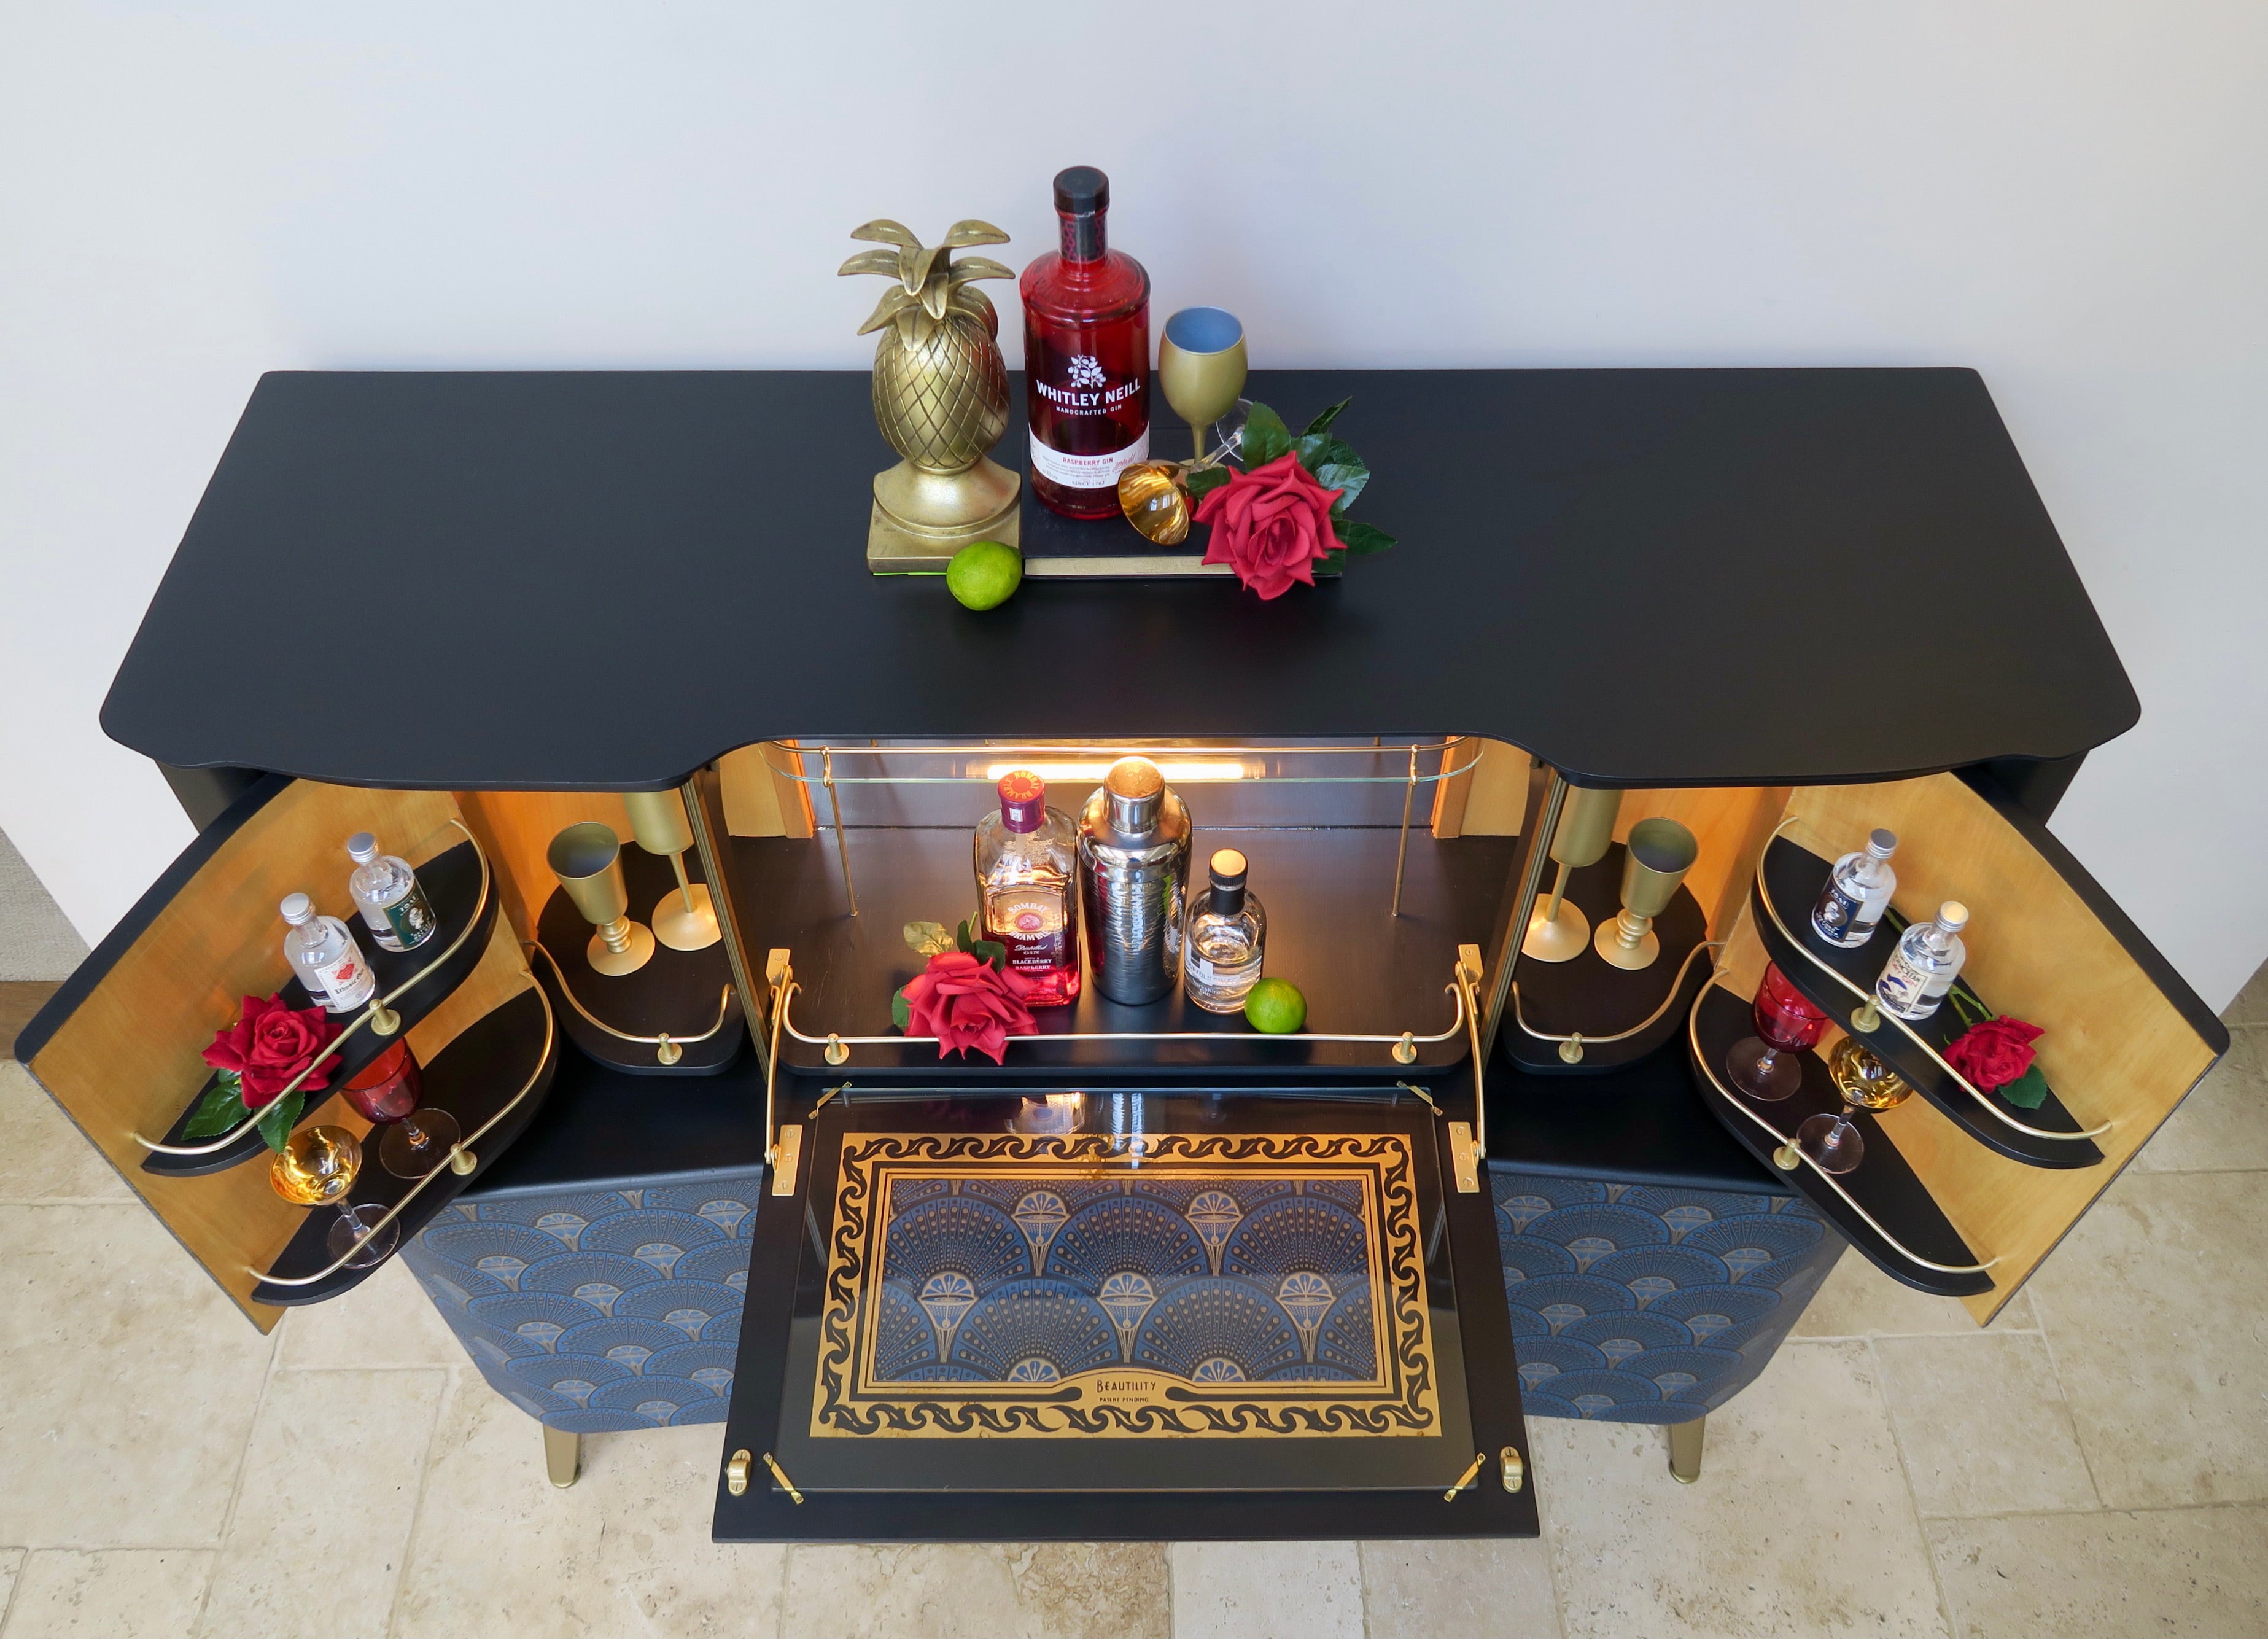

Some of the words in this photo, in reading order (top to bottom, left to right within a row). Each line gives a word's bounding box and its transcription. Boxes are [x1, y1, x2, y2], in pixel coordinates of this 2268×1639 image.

[1036, 379, 1100, 407] WHITLEY
[1106, 378, 1140, 404] NEILL
[1056, 406, 1106, 415] HANDCRAFTED
[1063, 457, 1100, 465] RASPBERRY
[1014, 771, 1039, 790] BOMBAY
[1003, 777, 1033, 799] BRAMBLE
[1007, 902, 1050, 914] BOMBAY
[1009, 930, 1052, 941] BRAMBLE
[1192, 978, 1220, 994] Yorkshire
[1901, 975, 1918, 987] GIN
[1097, 1379, 1156, 1393] BEAUTILITY
